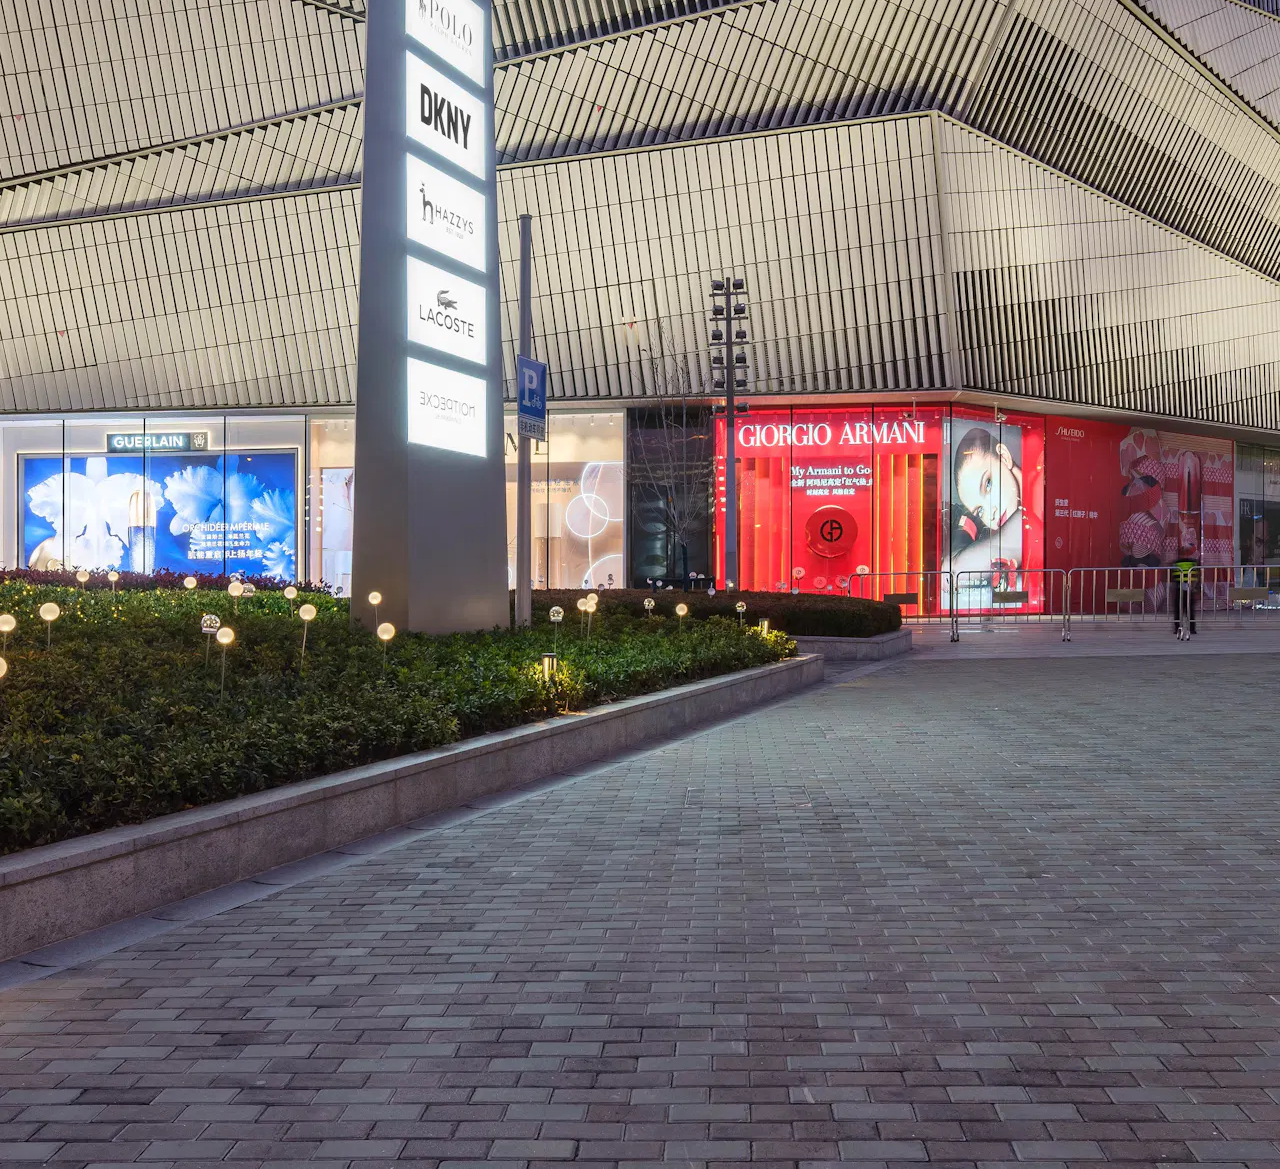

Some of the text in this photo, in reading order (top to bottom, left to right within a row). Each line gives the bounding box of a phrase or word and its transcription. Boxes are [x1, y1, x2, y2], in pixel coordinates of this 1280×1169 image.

[421, 82, 472, 150] DKNY
[435, 204, 475, 235] HAZZYS
[419, 304, 475, 339] LACOSTE
[523, 367, 538, 408] P
[113, 435, 183, 448] GUERLAIN
[738, 421, 926, 447] GIORGIO ARMANI
[1055, 426, 1085, 438] SHISEIDO
[791, 466, 806, 478] My
[806, 466, 842, 476] Armani
[844, 466, 854, 476] to
[229, 520, 270, 531] MPÉRIALE
